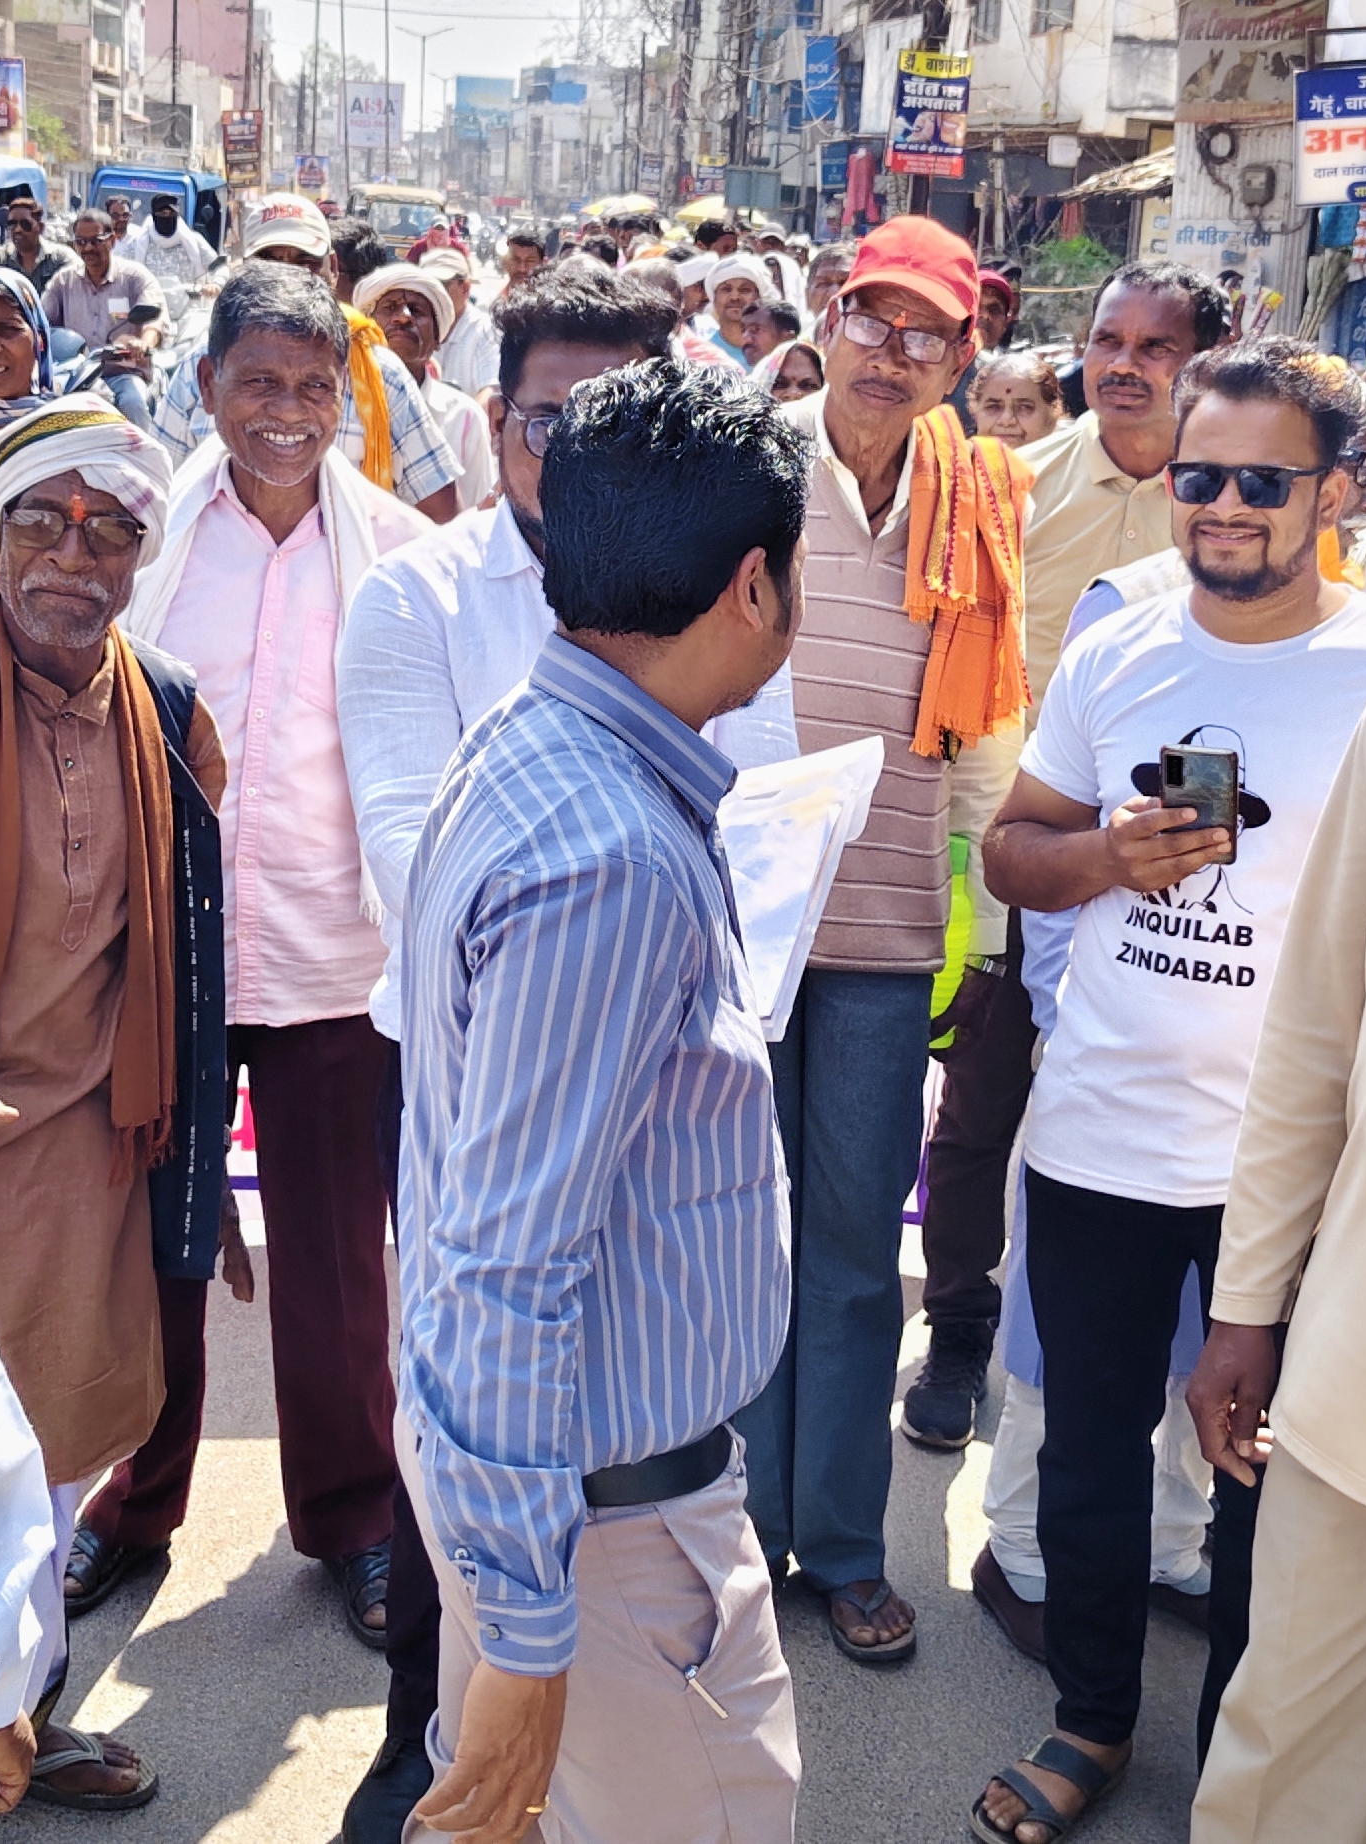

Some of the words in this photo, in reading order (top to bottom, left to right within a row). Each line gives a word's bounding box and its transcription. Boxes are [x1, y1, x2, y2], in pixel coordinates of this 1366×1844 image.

[902, 96, 964, 111] अस्पताल
[1313, 167, 1338, 179] दाल
[1125, 905, 1254, 947] INQUILAB
[1115, 941, 1255, 987] ZINDABAD
